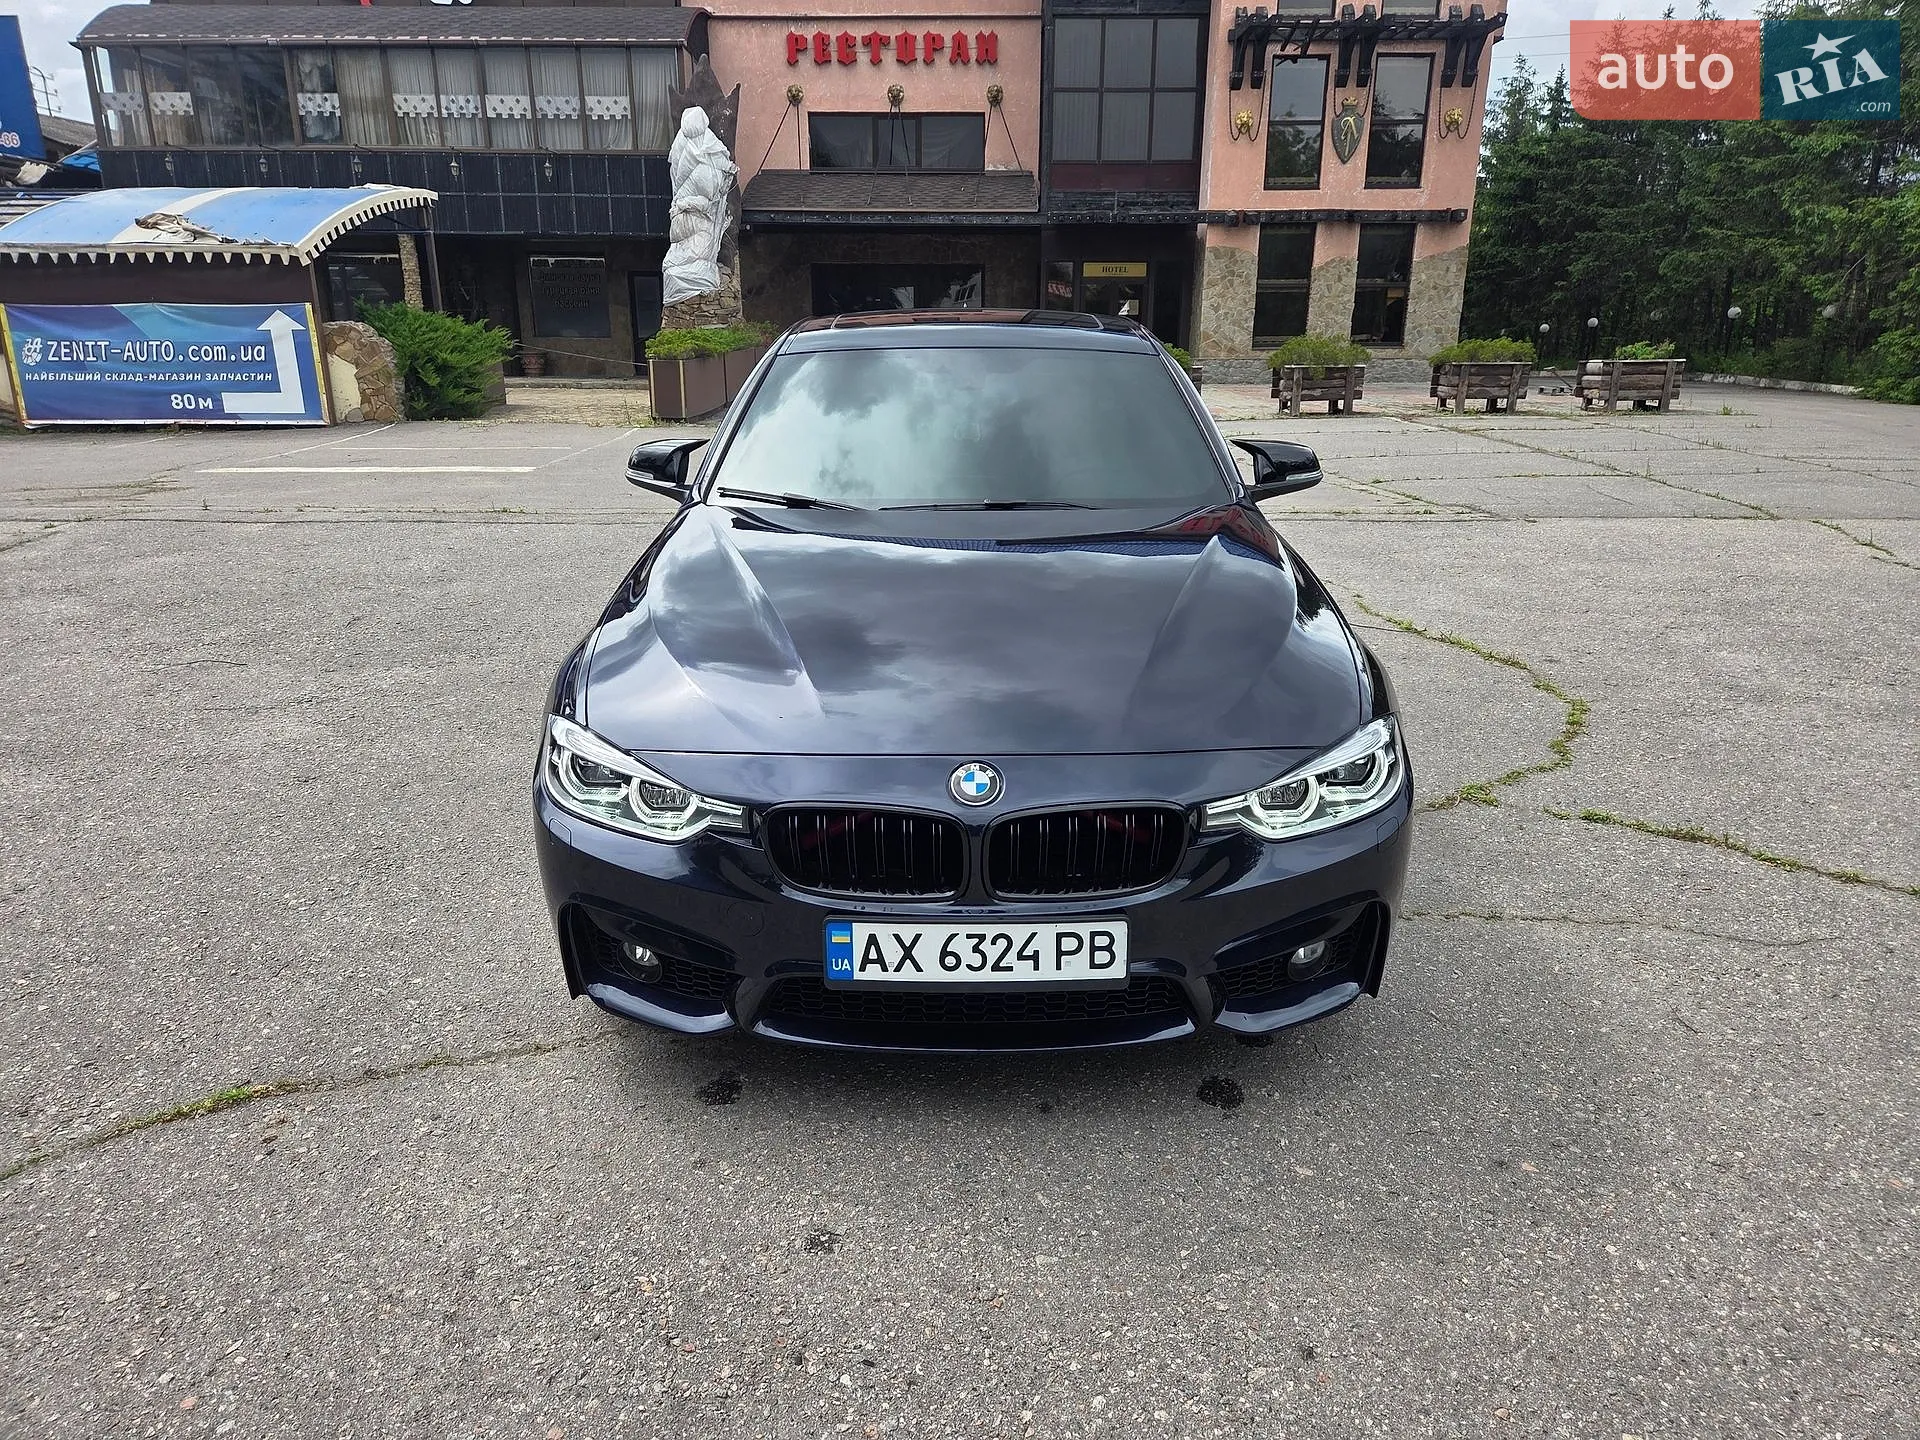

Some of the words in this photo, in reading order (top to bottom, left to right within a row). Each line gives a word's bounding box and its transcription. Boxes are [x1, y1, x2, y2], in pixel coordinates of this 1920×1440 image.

[786, 30, 998, 65] РЕСТОРАН
[47, 340, 266, 362] ZENIT-AUTO.com.ua
[25, 371, 101, 381] НАЙБІЛЬШИЙ
[105, 372, 201, 381] СКЛАД-МАГАЗИН
[205, 372, 272, 381] ЗАПЧАСТИН
[956, 764, 995, 777] BMW
[858, 932, 924, 973] AX
[938, 931, 1040, 973] 6324
[1055, 930, 1117, 971] PB
[832, 958, 851, 971] UA
